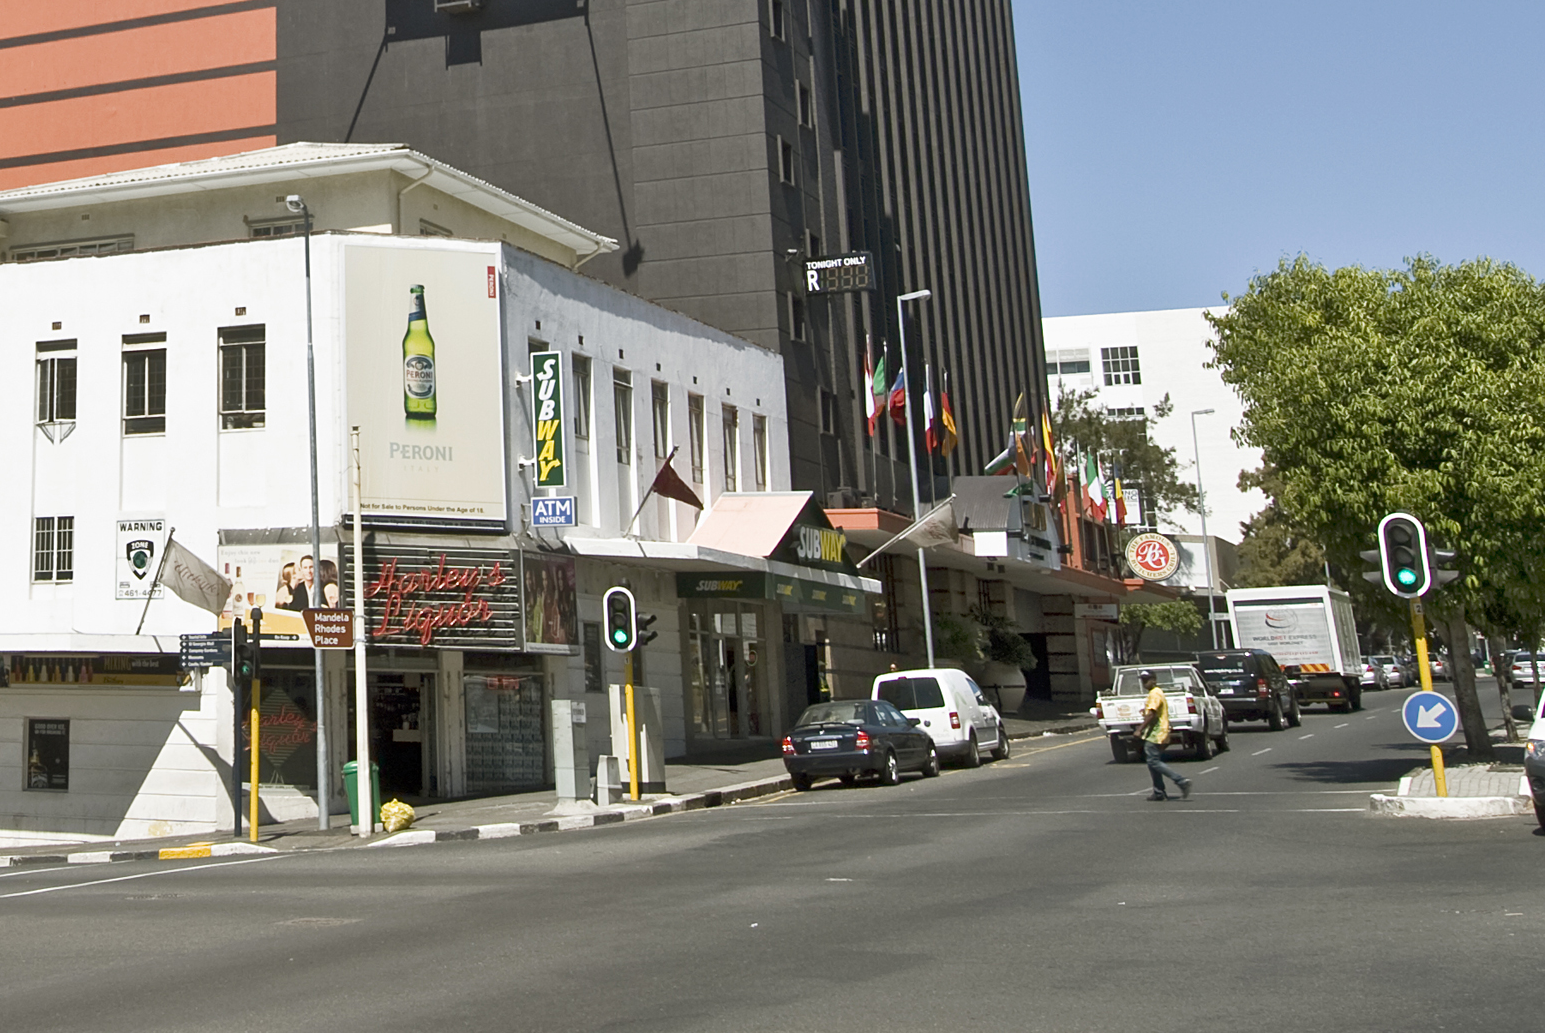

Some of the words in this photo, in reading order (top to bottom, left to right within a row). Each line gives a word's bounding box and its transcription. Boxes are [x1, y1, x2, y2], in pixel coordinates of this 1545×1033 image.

[806, 258, 842, 270] TONIGHT
[843, 256, 866, 266] ONLY
[406, 369, 433, 379] PERONI
[536, 358, 562, 482] SUBWAY
[389, 441, 454, 462] PERONI
[402, 504, 427, 512] Persons
[427, 504, 446, 512] Under
[456, 506, 469, 514] Age
[534, 500, 571, 516] ATM
[539, 516, 566, 524] INSIDE
[119, 522, 163, 532] WARNING
[131, 541, 149, 549] ZONE
[797, 526, 843, 563] SUBWAY
[363, 553, 506, 599] Harley's
[696, 580, 741, 592] SUBWAY
[314, 612, 349, 622] Mandela
[372, 592, 494, 646] Liquor
[314, 624, 347, 634] Rhodes
[314, 635, 339, 645] Place
